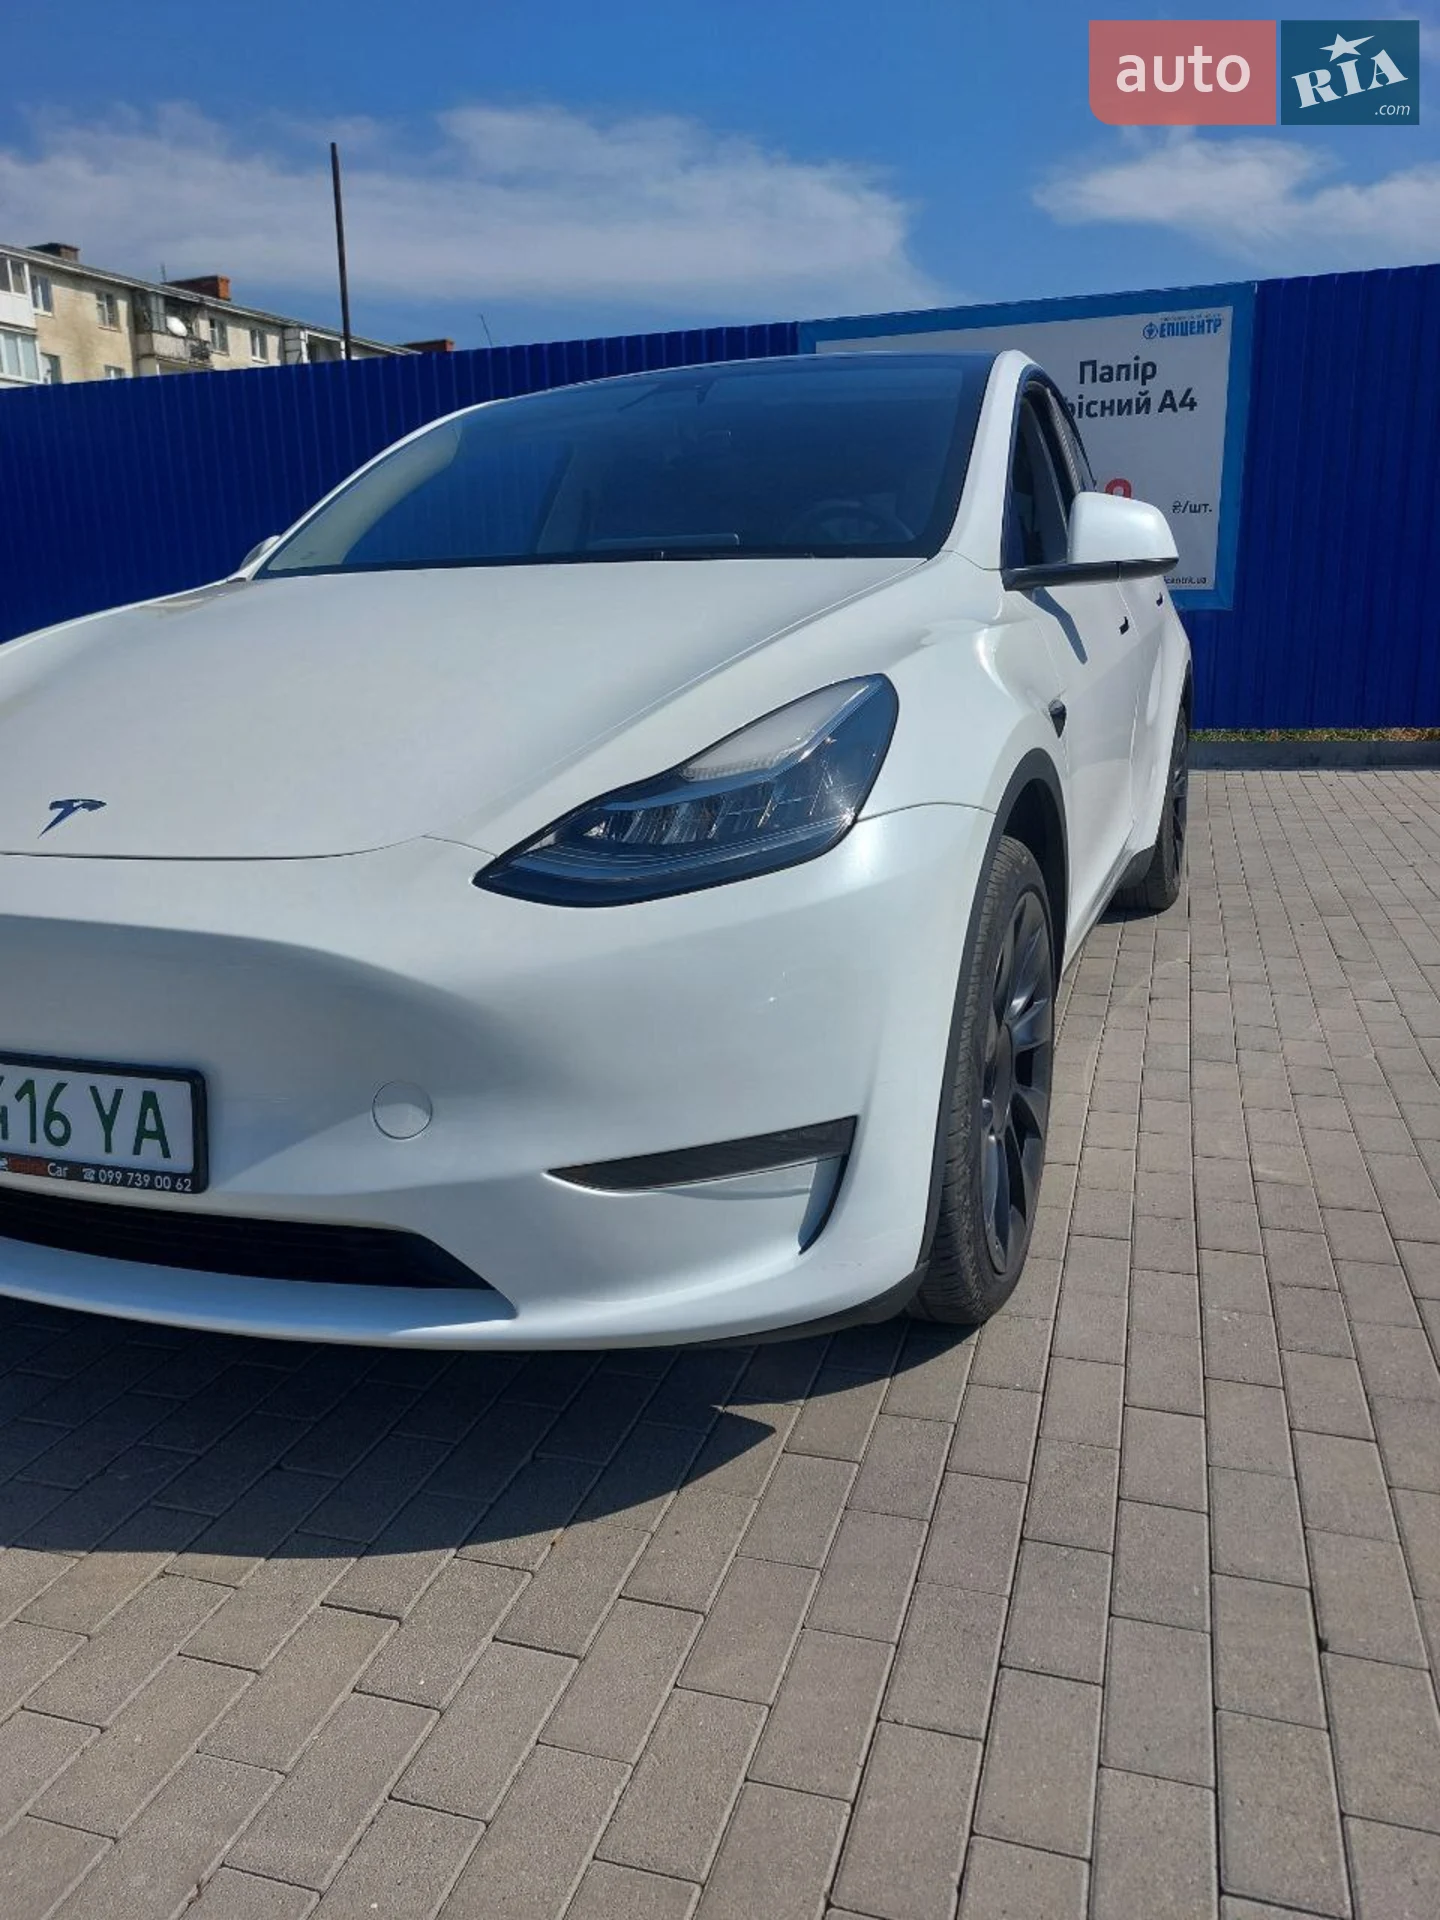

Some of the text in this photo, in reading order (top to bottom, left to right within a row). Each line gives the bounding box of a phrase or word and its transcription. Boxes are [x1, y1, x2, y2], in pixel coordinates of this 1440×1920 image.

[1159, 318, 1222, 338] ЕПІЦЕНТР
[1079, 355, 1157, 386] Папір
[1158, 387, 1198, 413] A4
[89, 1085, 172, 1159] YA
[47, 1162, 192, 1192] Car 099 739 00 62
